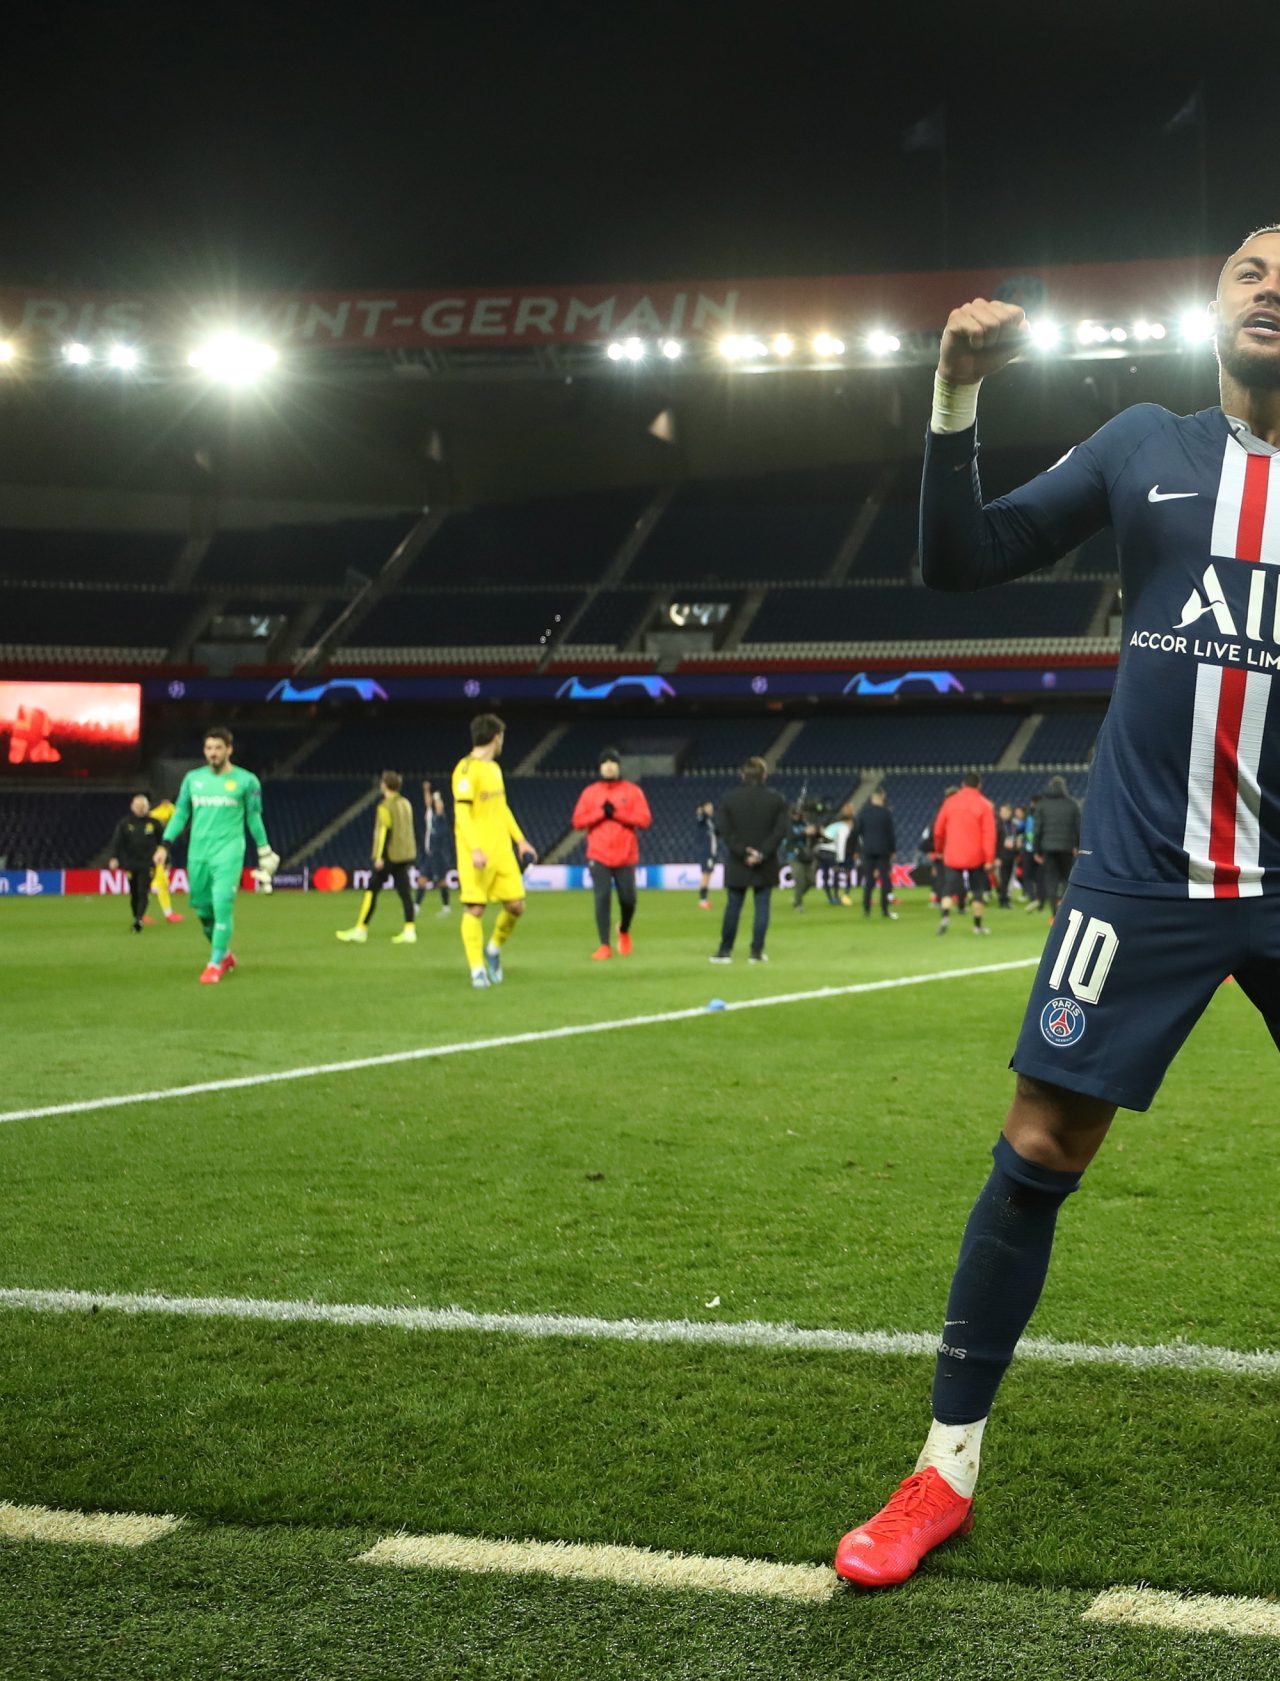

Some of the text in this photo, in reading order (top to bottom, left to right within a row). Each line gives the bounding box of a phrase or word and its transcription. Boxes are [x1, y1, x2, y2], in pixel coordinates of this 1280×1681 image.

[1130, 629, 1187, 654] ACCOR
[1193, 640, 1241, 662] LIVE
[1048, 908, 1120, 1005] 10
[1052, 1000, 1081, 1017] PARIS
